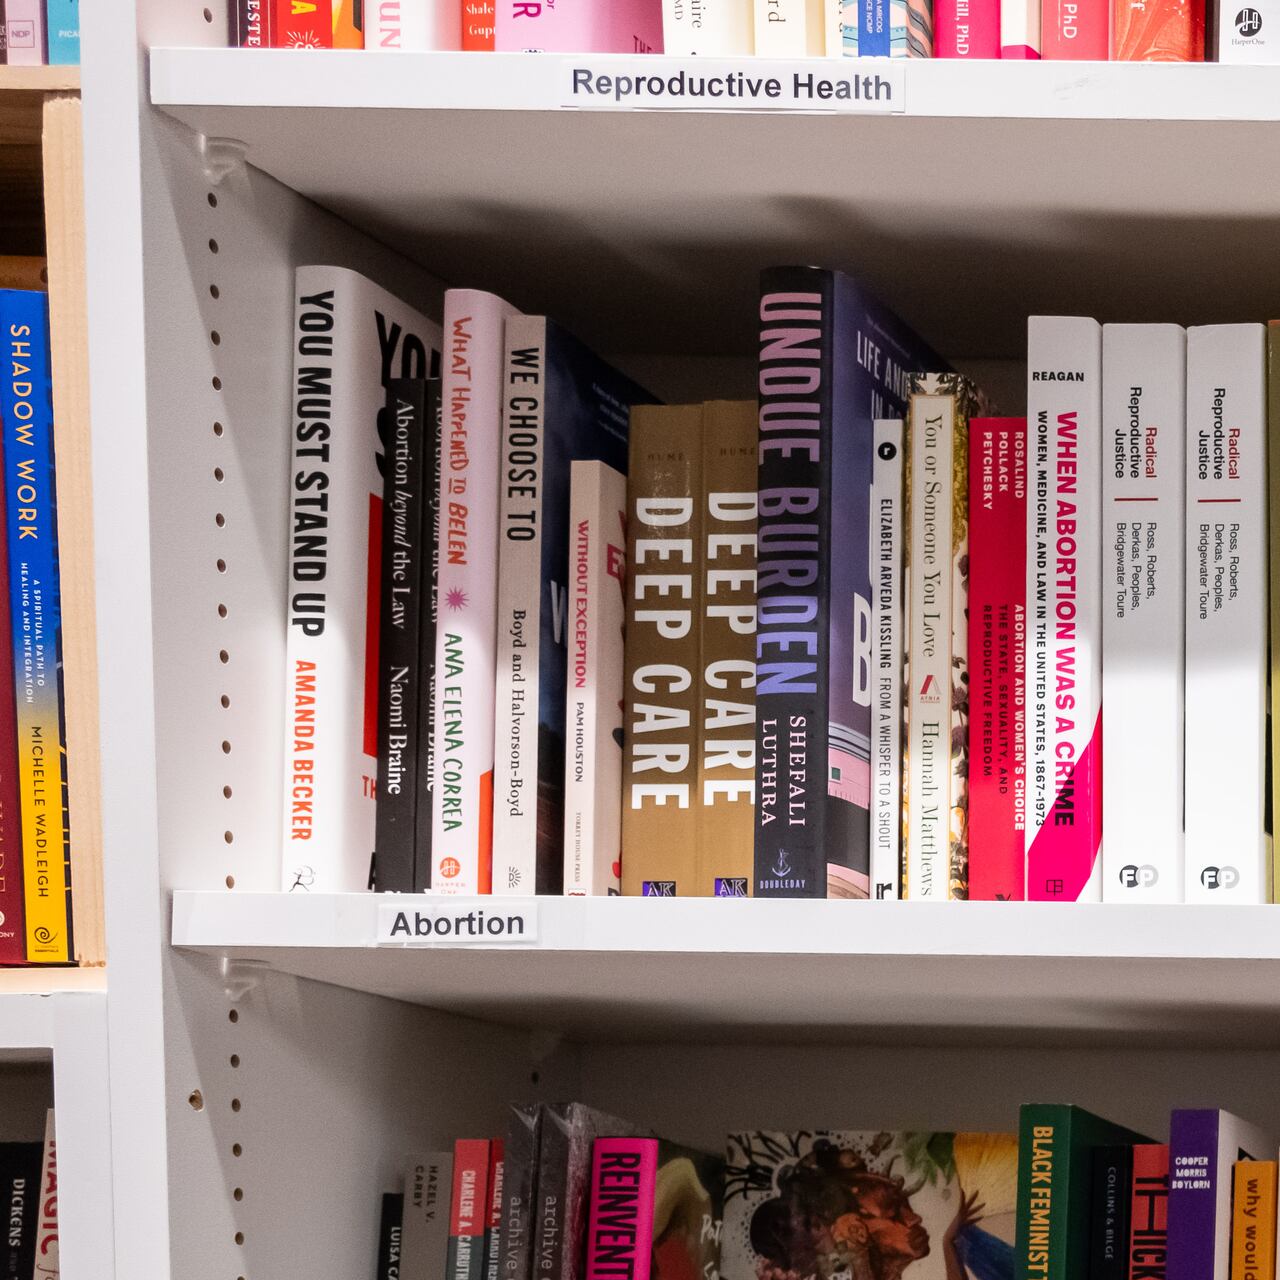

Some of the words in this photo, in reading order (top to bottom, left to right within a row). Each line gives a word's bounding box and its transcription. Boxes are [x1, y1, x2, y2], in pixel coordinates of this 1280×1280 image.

[572, 68, 783, 101] Reproductive
[792, 73, 893, 100] Health
[298, 290, 335, 357] YOU
[10, 324, 35, 447] SHADOW
[296, 367, 332, 462] MUST
[759, 292, 822, 464] UNDUE
[1054, 411, 1078, 496] WHEN
[17, 459, 38, 541] WORK
[293, 471, 329, 582] STAND
[634, 497, 693, 640] DEEP
[756, 487, 819, 696] BURDEN
[1054, 500, 1077, 641] ABORTION
[292, 593, 326, 637] UP
[442, 633, 464, 679] ANA
[293, 659, 317, 752] AMANDA
[443, 686, 465, 751] ELENA
[1054, 646, 1076, 713] WAS
[30, 726, 45, 809] MICHELLE
[631, 662, 690, 810] CARE
[1054, 718, 1075, 736] A
[292, 760, 315, 840] BECKER
[441, 758, 464, 832] CORREA
[761, 718, 779, 827] LUTHRA
[788, 715, 808, 827] SHEFALI
[1053, 740, 1075, 827] CRIME
[34, 814, 50, 898] WADLEIGH
[389, 910, 525, 937] Abortion
[1030, 1125, 1054, 1184] BLACK
[1028, 1187, 1051, 1273] FEMINIST
